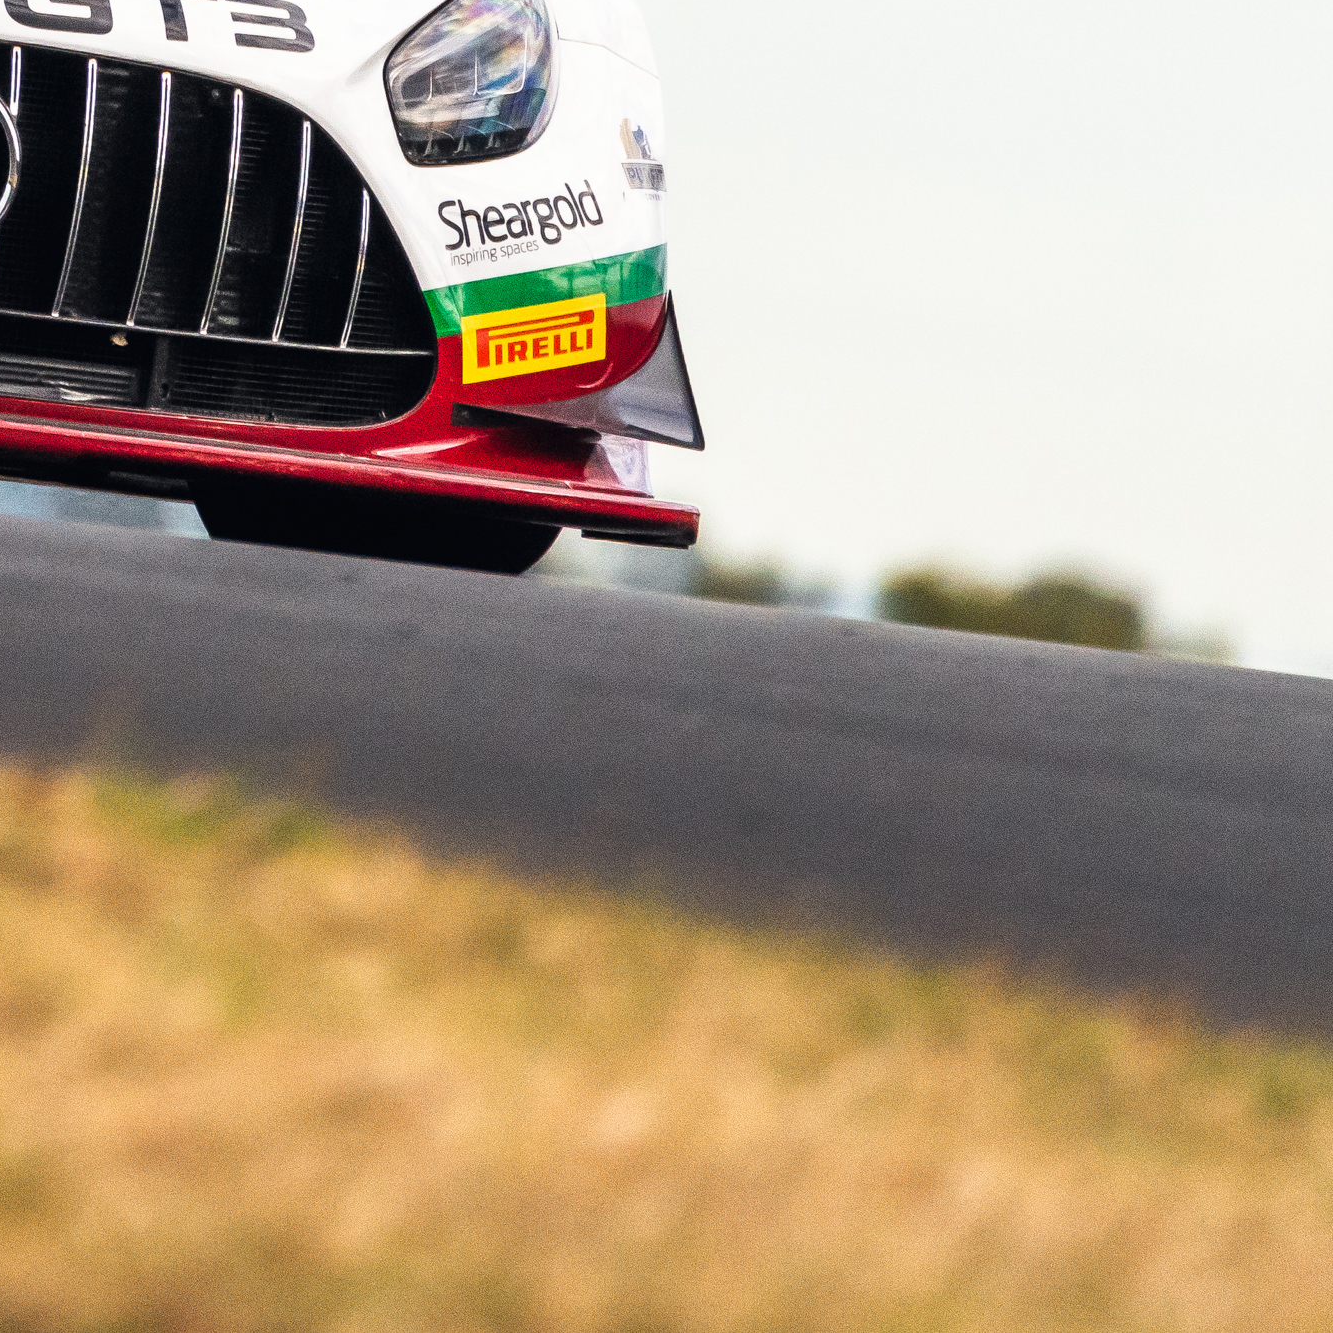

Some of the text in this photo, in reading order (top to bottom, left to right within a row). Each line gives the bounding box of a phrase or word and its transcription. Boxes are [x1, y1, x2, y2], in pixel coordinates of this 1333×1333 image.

[438, 179, 604, 251] Sheargold
[450, 239, 540, 267] inspiring spaces
[475, 309, 595, 369] PIRELLI
